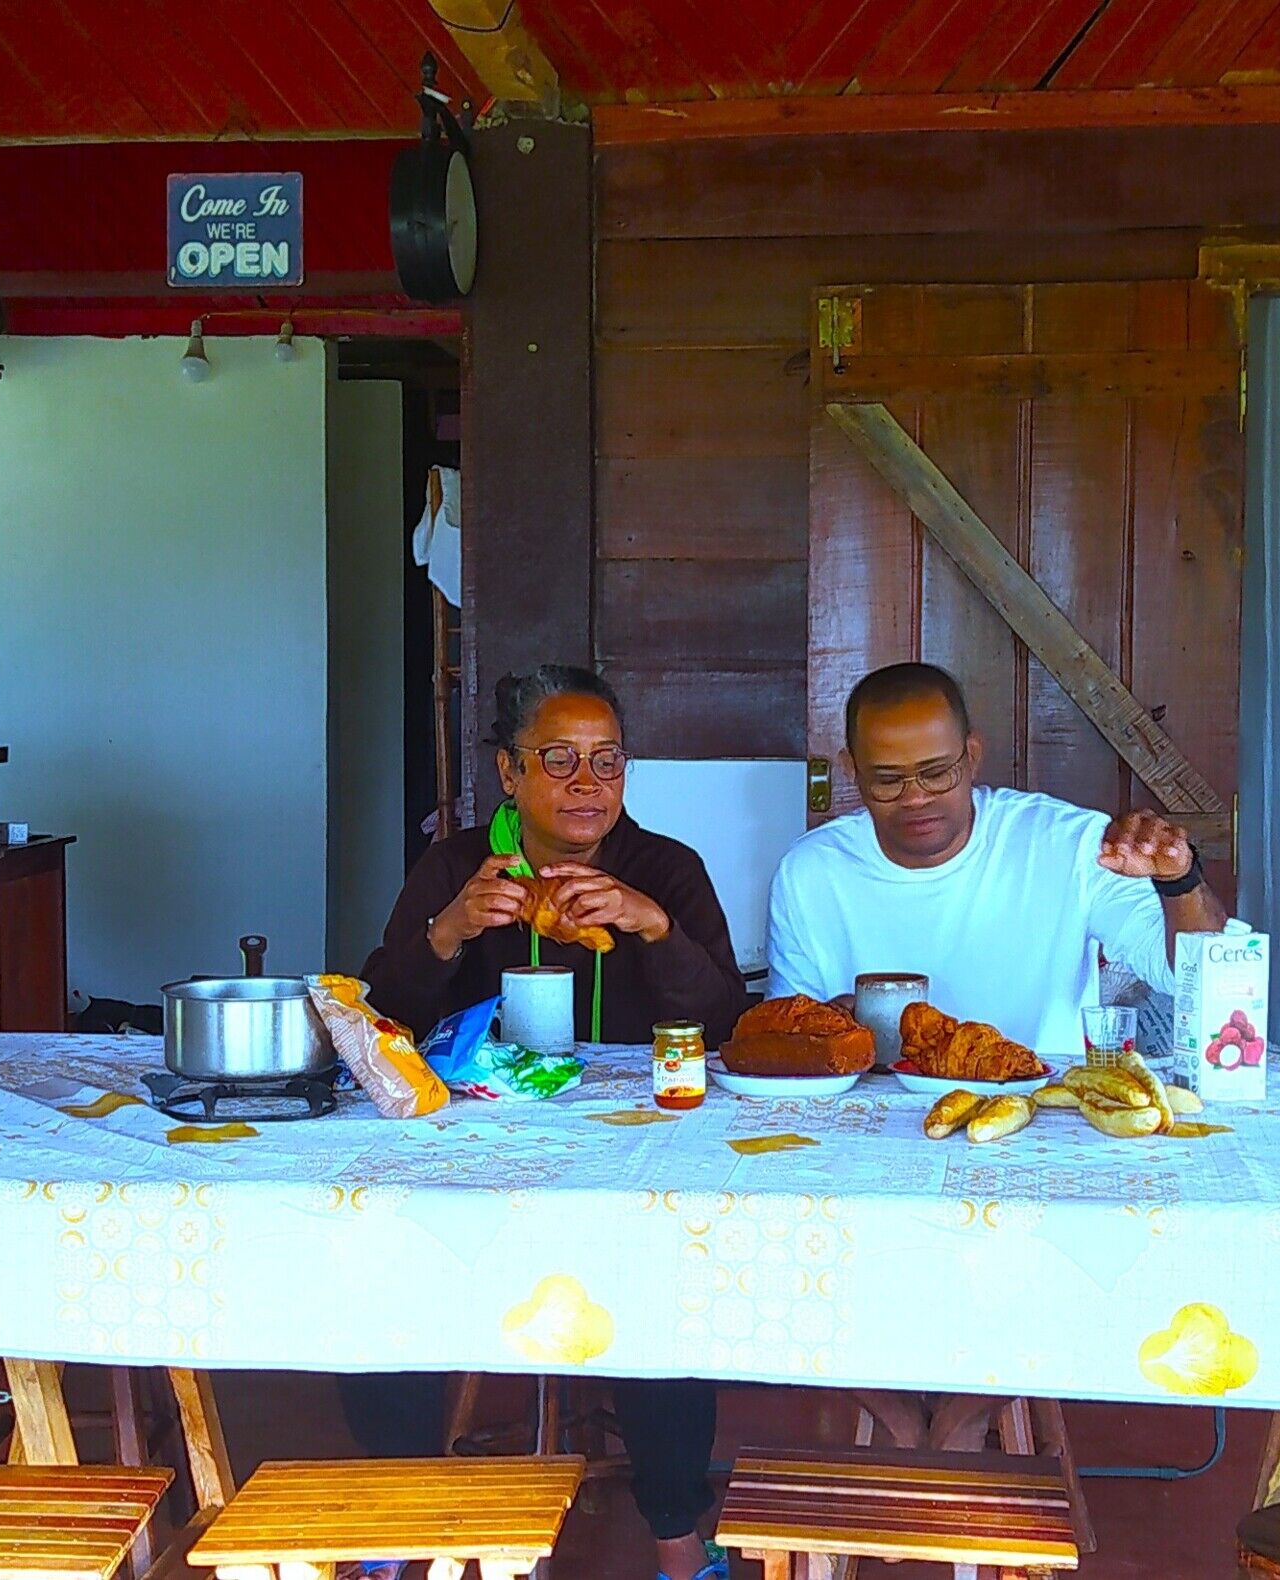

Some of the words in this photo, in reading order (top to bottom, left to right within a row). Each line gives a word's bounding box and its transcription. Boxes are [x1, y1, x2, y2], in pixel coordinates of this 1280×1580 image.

[180, 184, 247, 223] Come
[250, 185, 290, 217] In
[206, 223, 256, 240] WE'RE
[177, 241, 289, 278] OPEN
[1208, 943, 1263, 964] Ceres
